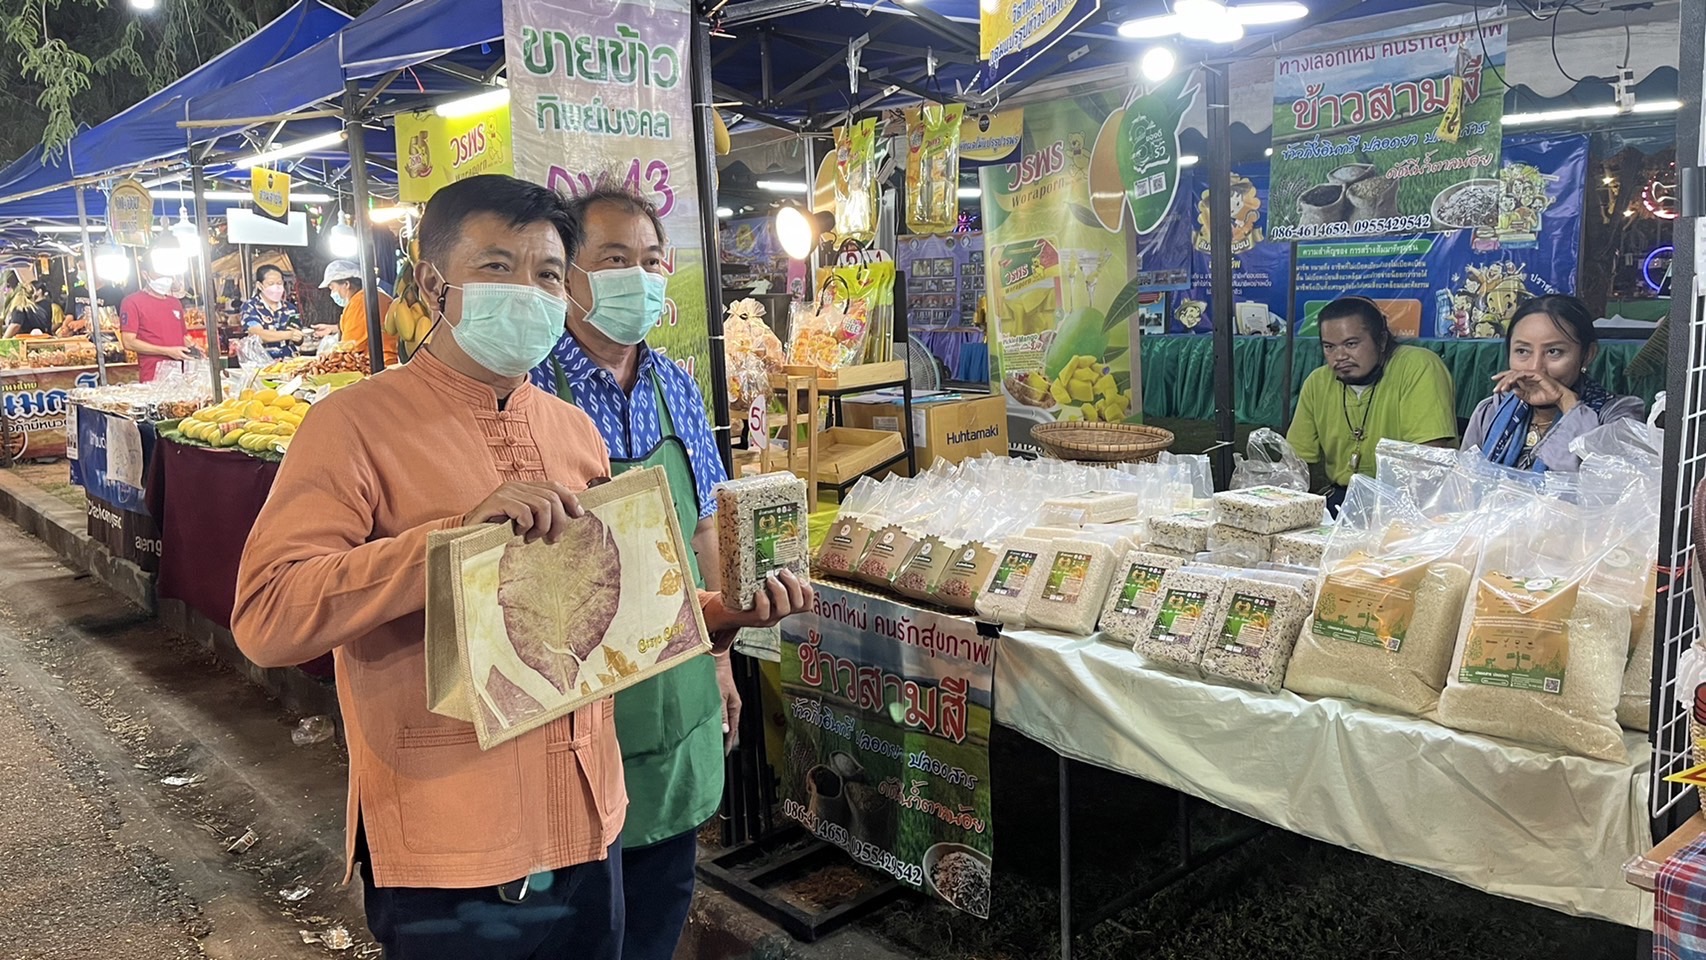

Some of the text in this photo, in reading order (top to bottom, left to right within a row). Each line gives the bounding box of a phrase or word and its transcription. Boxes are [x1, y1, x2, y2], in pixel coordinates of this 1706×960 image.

[522, 24, 681, 89] ขายข้าว
[449, 123, 486, 169] วรพร
[1005, 139, 1064, 191] วรพร
[1011, 176, 1065, 208] Woraporn
[1271, 213, 1431, 241] 086-4614659, 0955429542
[946, 424, 999, 445] Huhtamaki
[811, 591, 868, 631] ลือกใหม่
[797, 628, 968, 744] ข้าวสามสี
